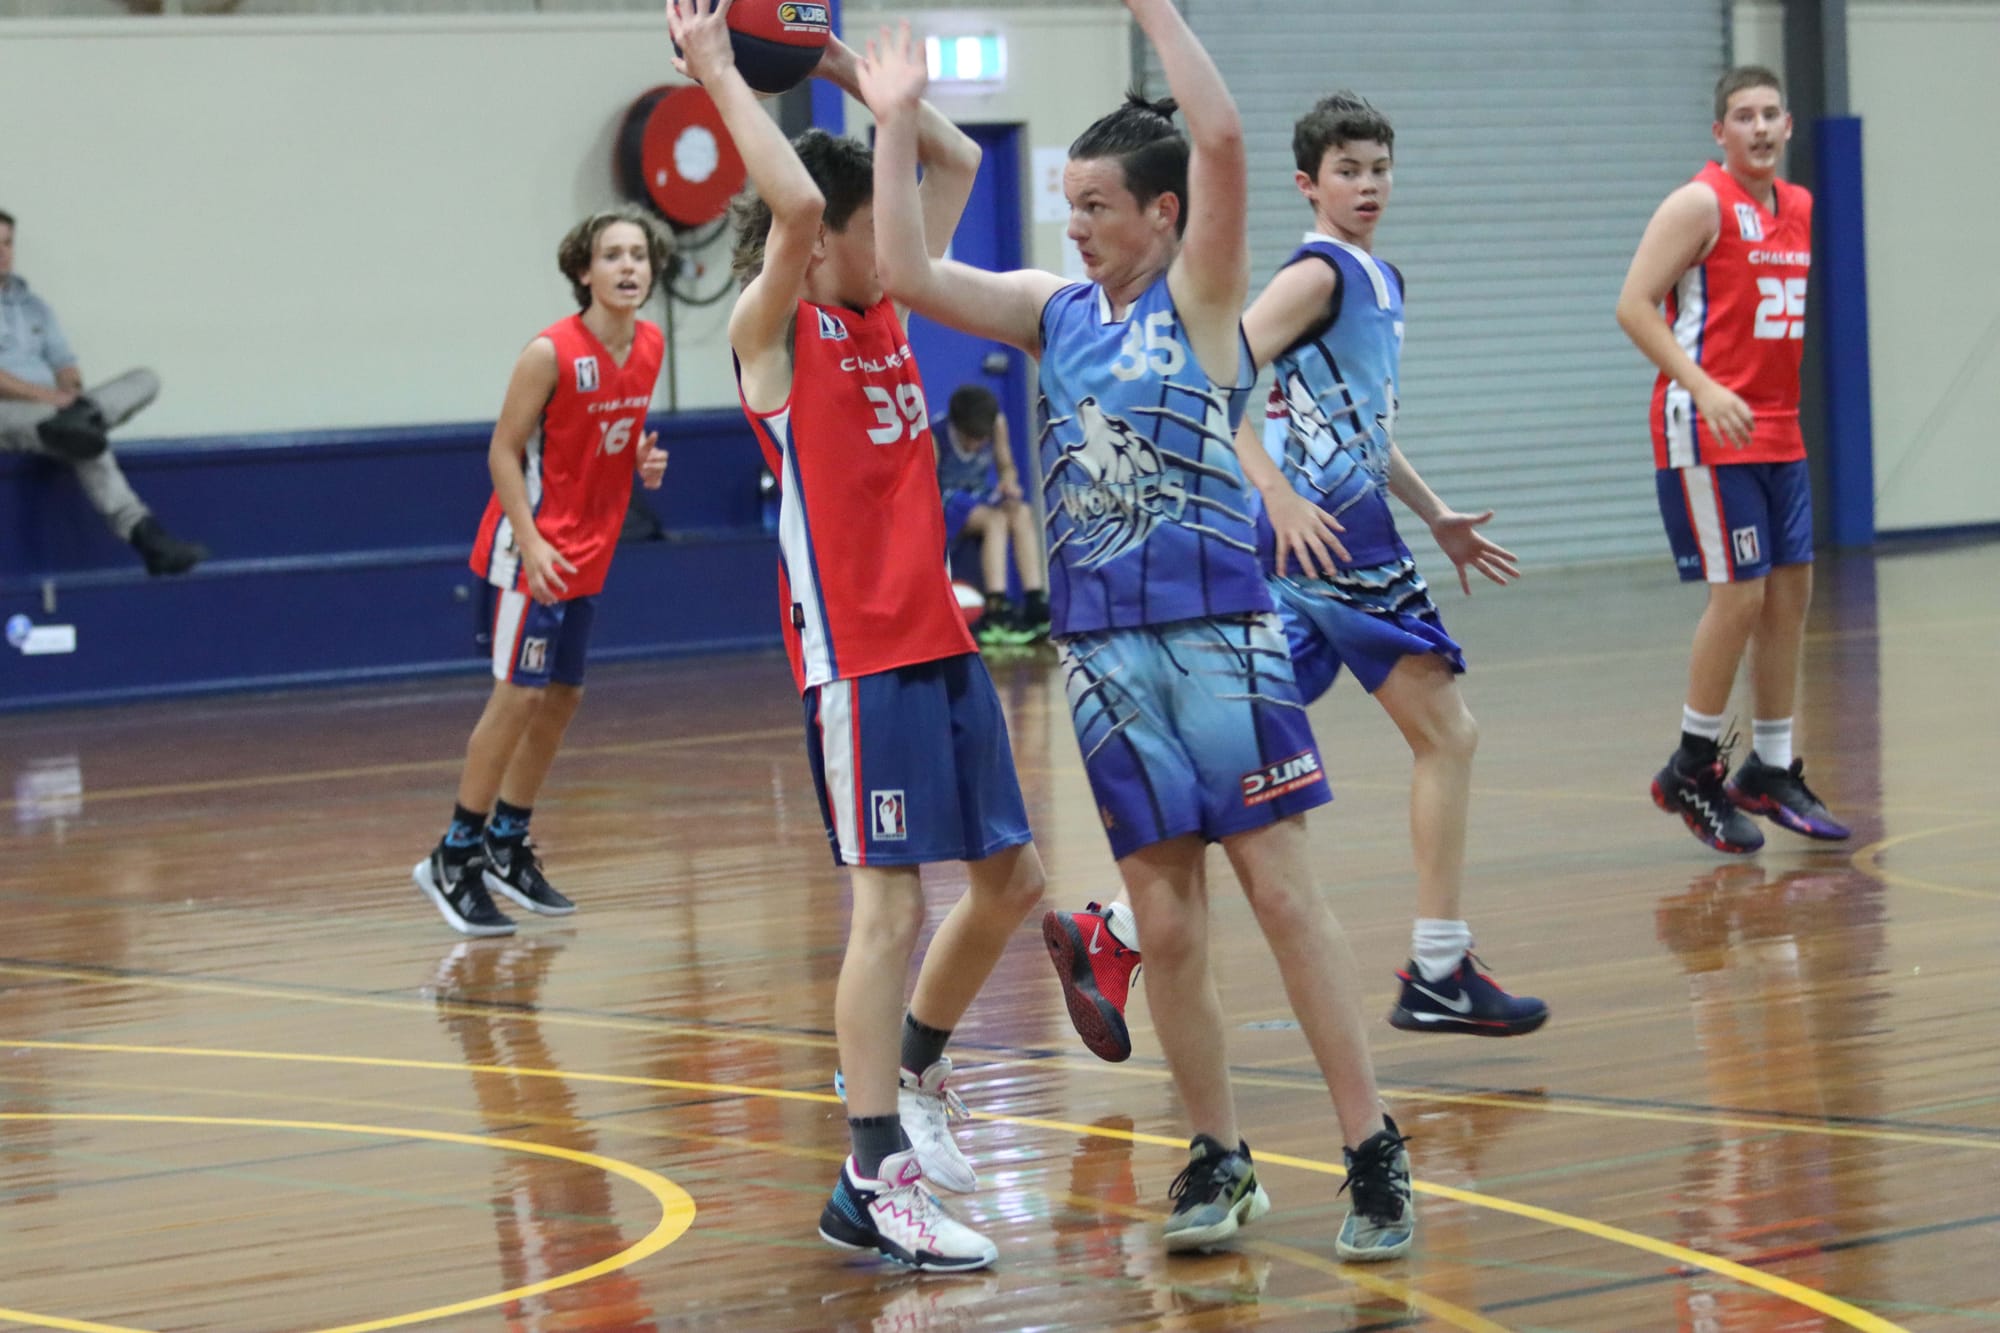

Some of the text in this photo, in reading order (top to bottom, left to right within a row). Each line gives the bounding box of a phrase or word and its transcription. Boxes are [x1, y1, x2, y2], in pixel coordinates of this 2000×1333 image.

[1753, 277, 1807, 339] 25
[1110, 310, 1187, 382] 35
[863, 383, 929, 445] 39
